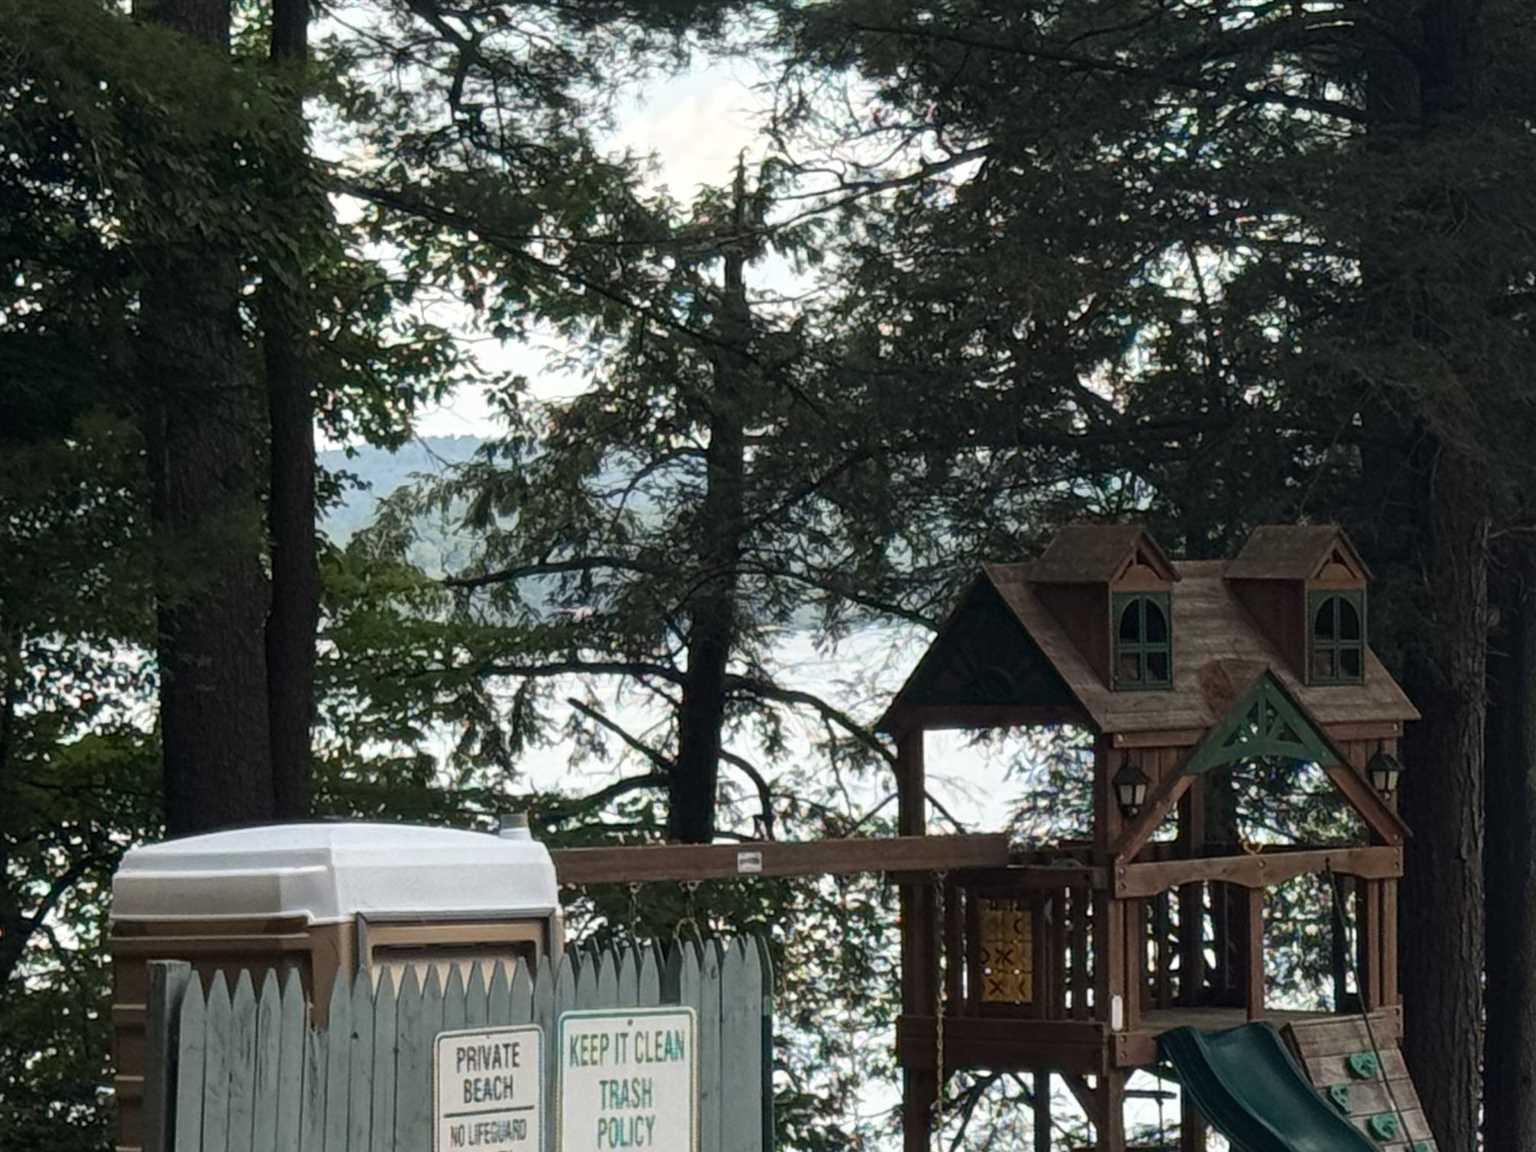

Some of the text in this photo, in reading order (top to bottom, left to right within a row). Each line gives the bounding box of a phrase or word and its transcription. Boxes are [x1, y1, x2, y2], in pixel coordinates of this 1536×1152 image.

[456, 1042, 520, 1073] PRIVATE
[569, 1029, 685, 1067] KEEP IT CLEAN
[463, 1076, 514, 1104] BEACH
[599, 1077, 653, 1111] TRASH
[450, 1118, 527, 1148] NO LIFEGUARD
[597, 1115, 656, 1150] POLICY
